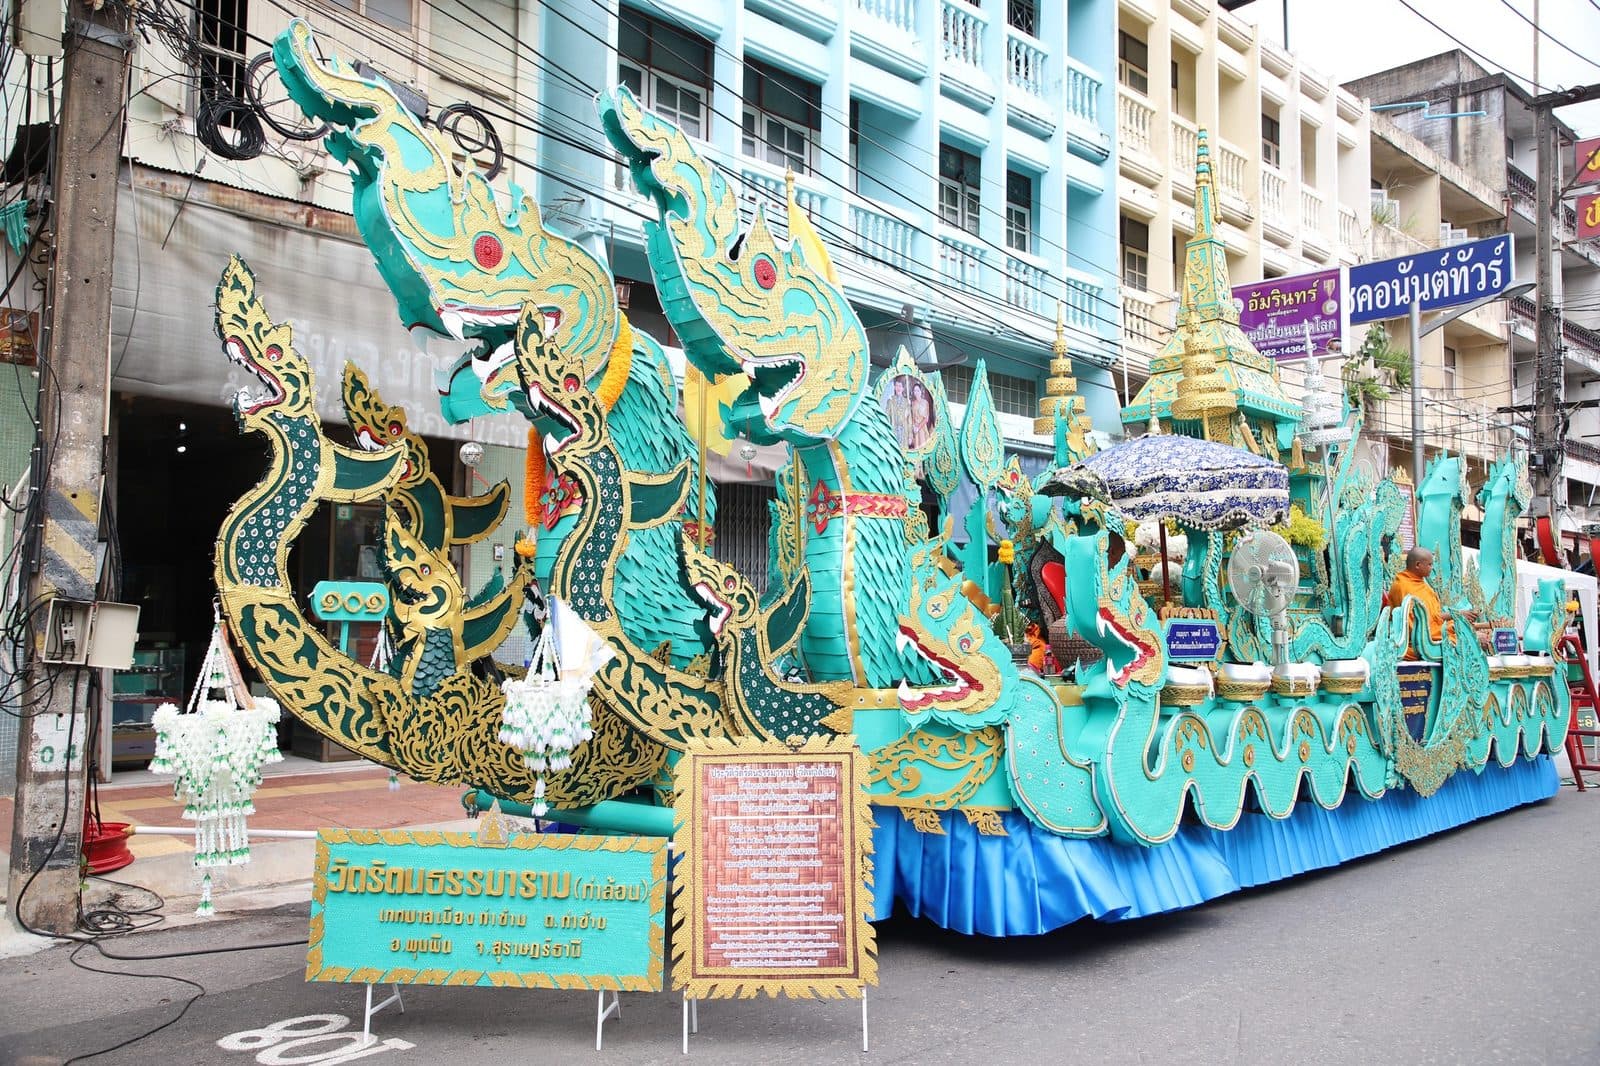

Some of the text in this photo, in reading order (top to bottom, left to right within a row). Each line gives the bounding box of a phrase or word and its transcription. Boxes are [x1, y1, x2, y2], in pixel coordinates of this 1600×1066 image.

[1248, 280, 1319, 312] อัมรินทร์
[328, 859, 572, 899] วัดรัตนธรรมาราม
